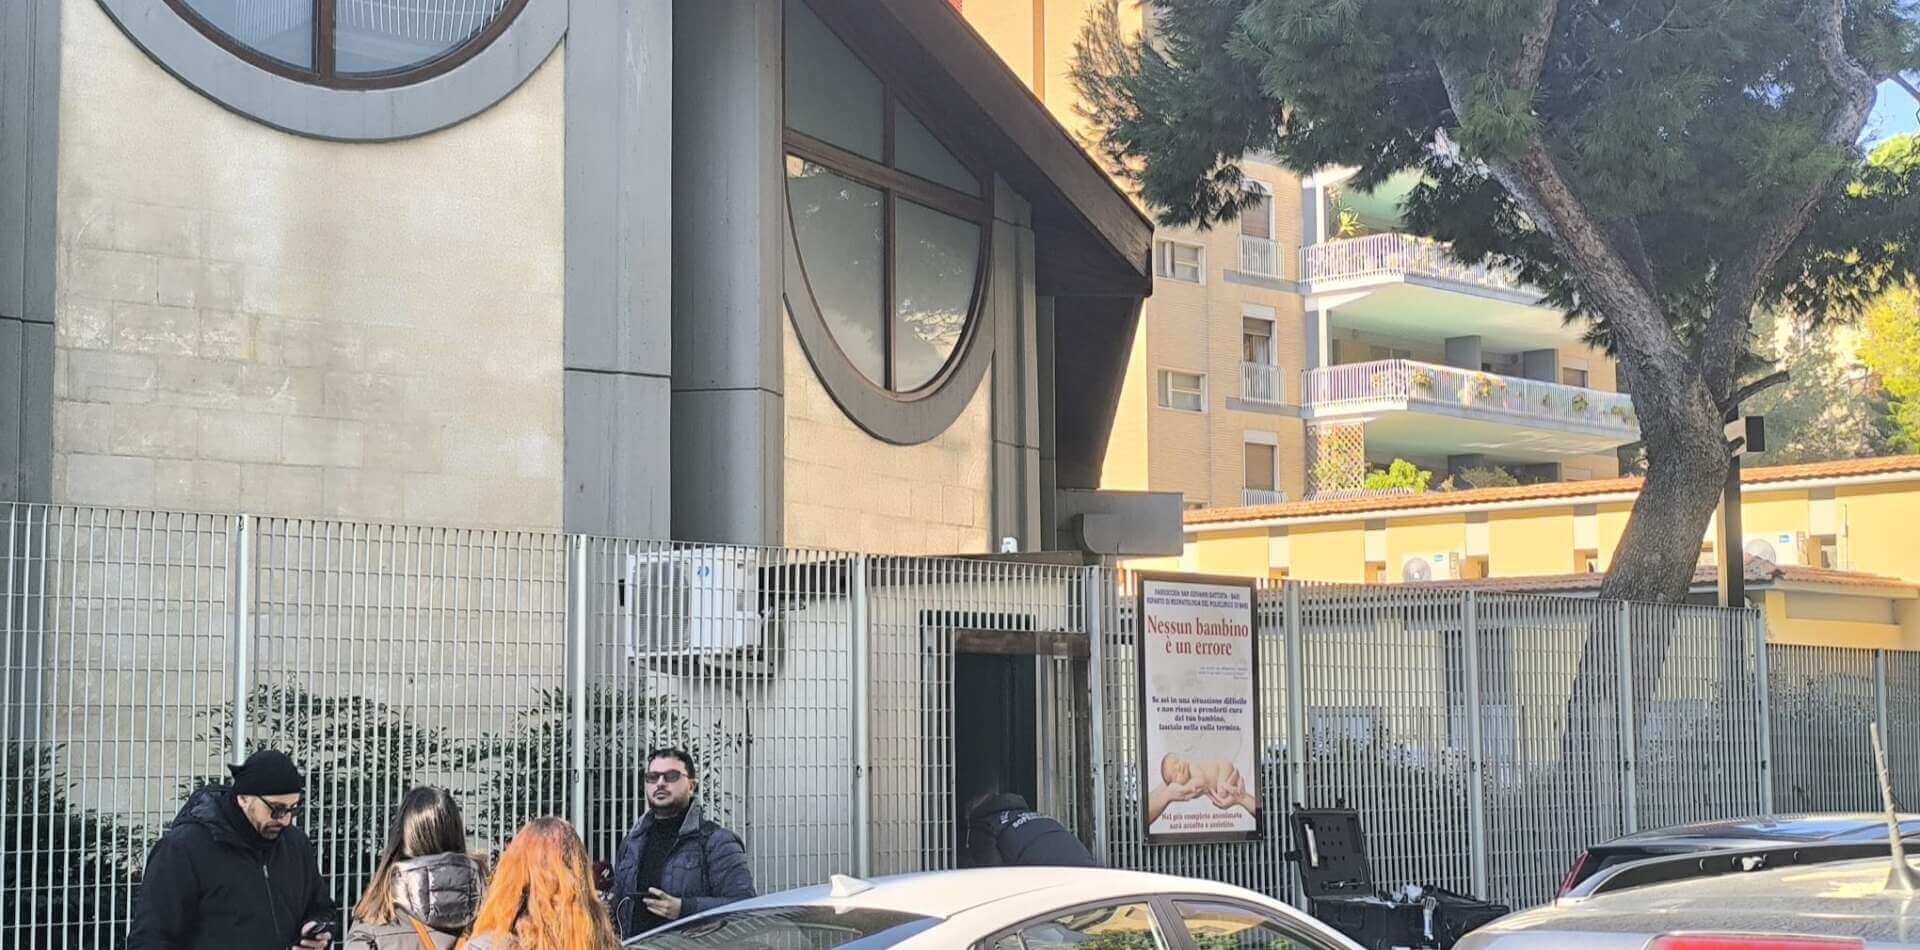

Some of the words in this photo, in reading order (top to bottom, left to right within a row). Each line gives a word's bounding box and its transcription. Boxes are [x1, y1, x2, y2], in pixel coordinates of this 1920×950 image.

[1148, 615, 1192, 634] Nessun
[1196, 616, 1248, 637] bambino
[1166, 634, 1172, 654] è
[1176, 641, 1192, 654] un
[1196, 641, 1232, 656] errore
